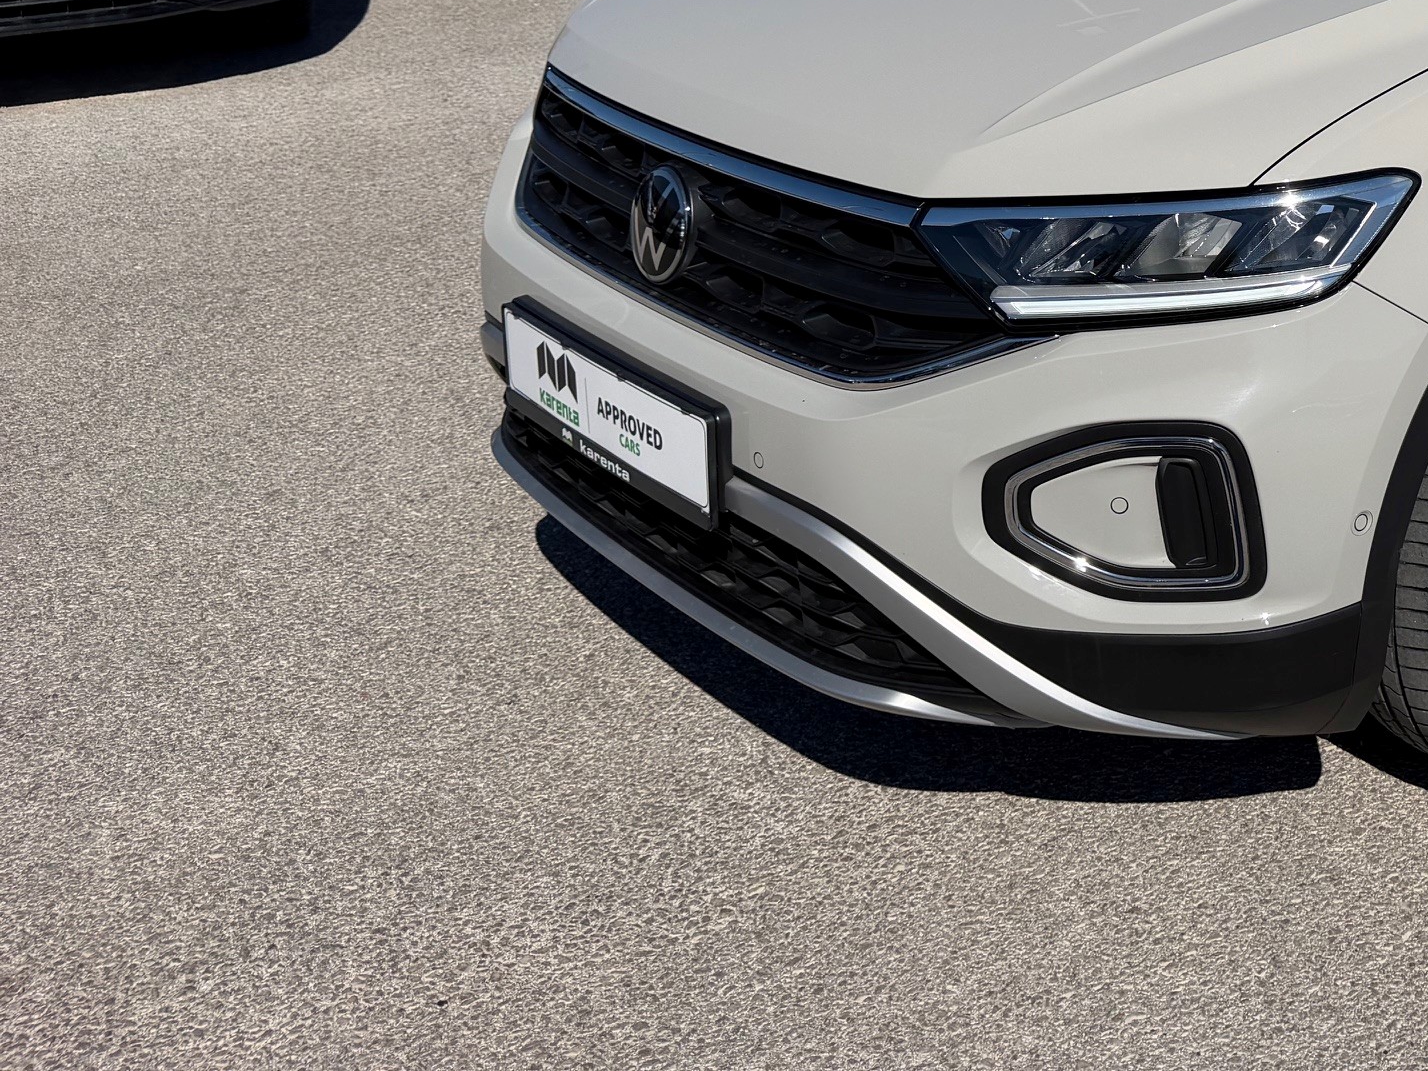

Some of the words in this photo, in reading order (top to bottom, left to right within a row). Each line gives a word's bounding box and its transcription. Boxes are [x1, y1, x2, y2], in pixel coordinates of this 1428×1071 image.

[539, 386, 580, 427] karenta
[596, 396, 663, 451] APPROVED
[579, 439, 631, 482] karenta
[618, 433, 641, 457] CARS
